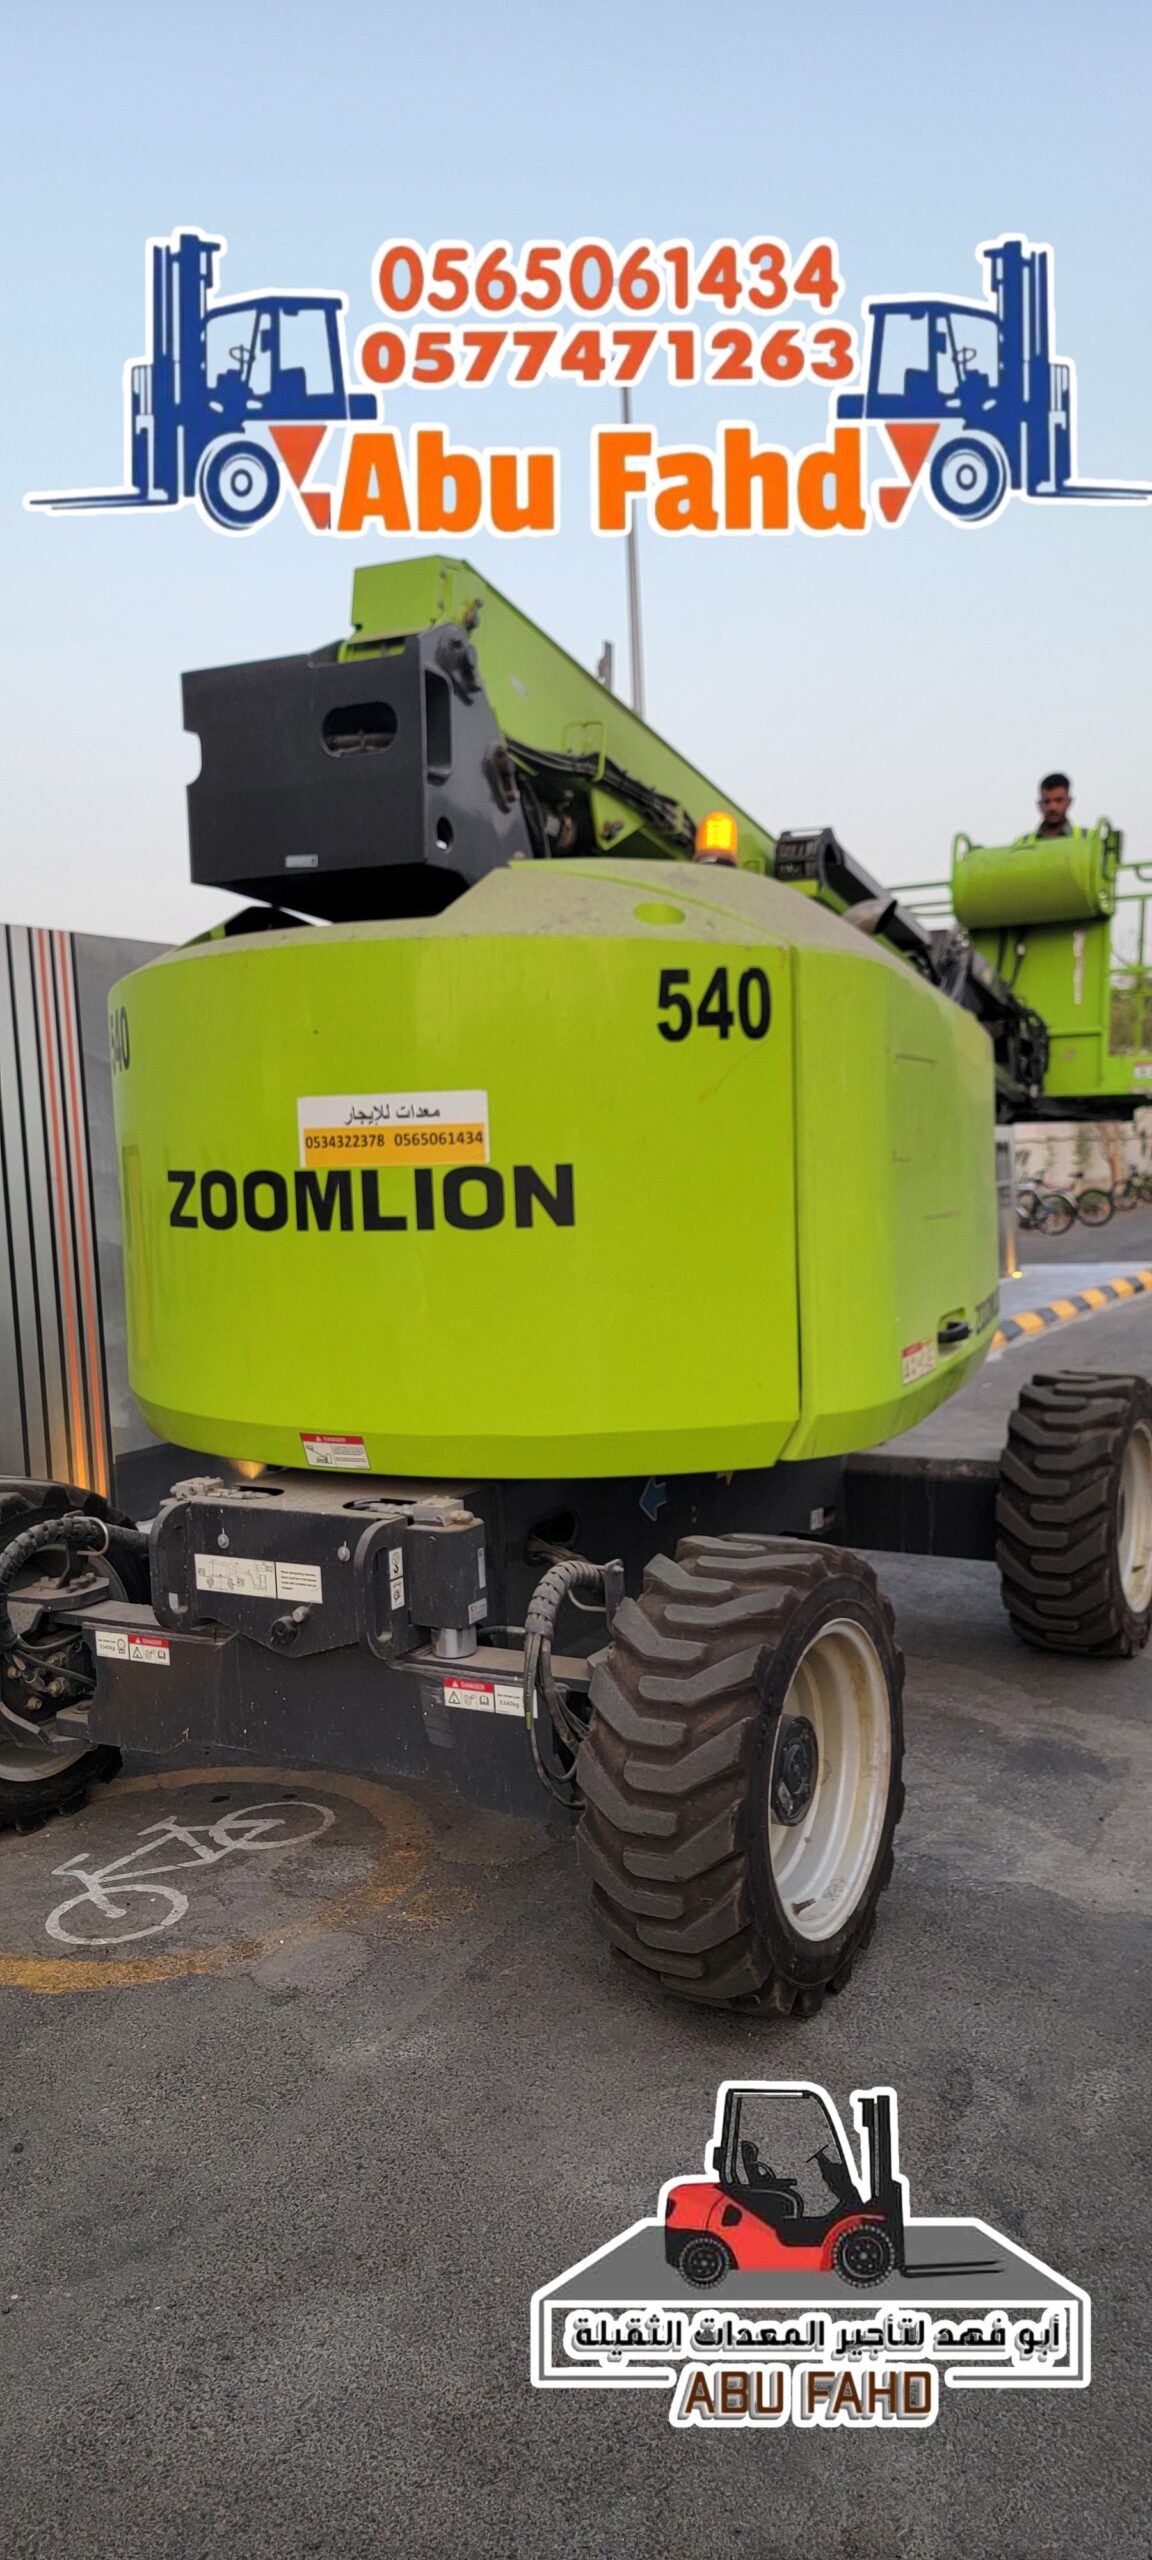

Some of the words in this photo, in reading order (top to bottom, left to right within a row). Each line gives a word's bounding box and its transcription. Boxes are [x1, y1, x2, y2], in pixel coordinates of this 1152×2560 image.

[656, 966, 772, 1042] 540
[344, 1104, 390, 1126] للإيجار
[395, 1104, 441, 1119] معدات
[305, 1134, 385, 1149] 0534322378
[394, 1131, 483, 1147] 0565061434
[167, 1163, 575, 1232] ZOOMLION
[461, 1681, 485, 1691] DANGER
